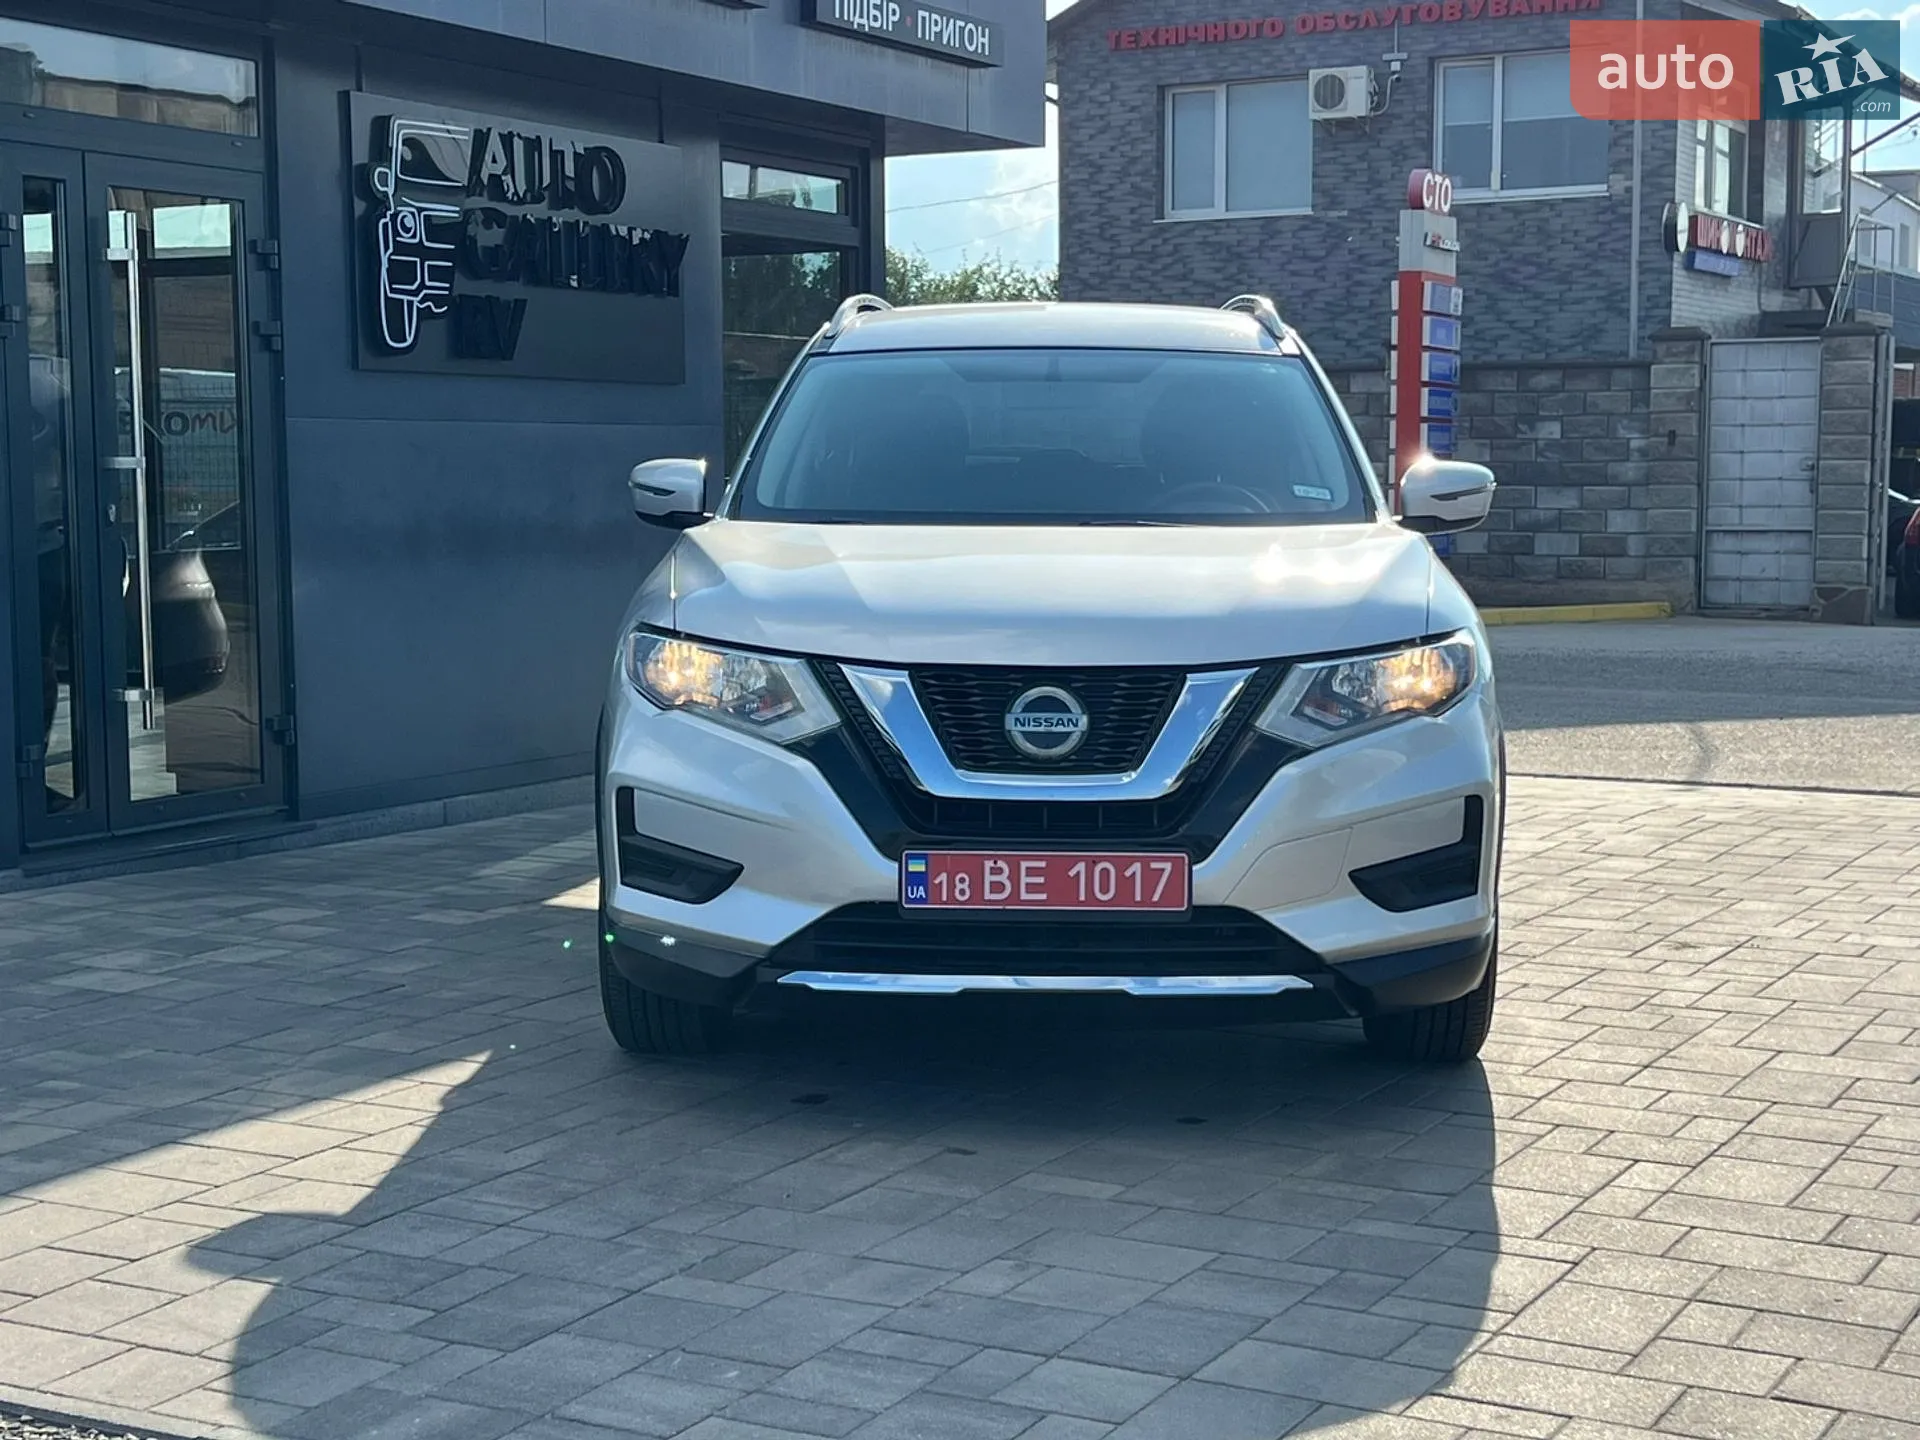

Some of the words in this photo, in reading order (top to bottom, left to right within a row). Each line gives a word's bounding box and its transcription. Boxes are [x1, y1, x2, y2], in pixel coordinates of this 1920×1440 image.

[917, 9, 989, 56] ПРИГОН
[1107, 16, 1284, 50] ТЕХНІЧНОГО
[467, 126, 627, 216] AUTO
[1423, 171, 1452, 213] СТО
[1014, 717, 1079, 728] NISSAN
[908, 886, 926, 899] UA
[934, 872, 970, 901] 18
[984, 859, 1048, 901] BE
[1068, 861, 1173, 902] 1017
